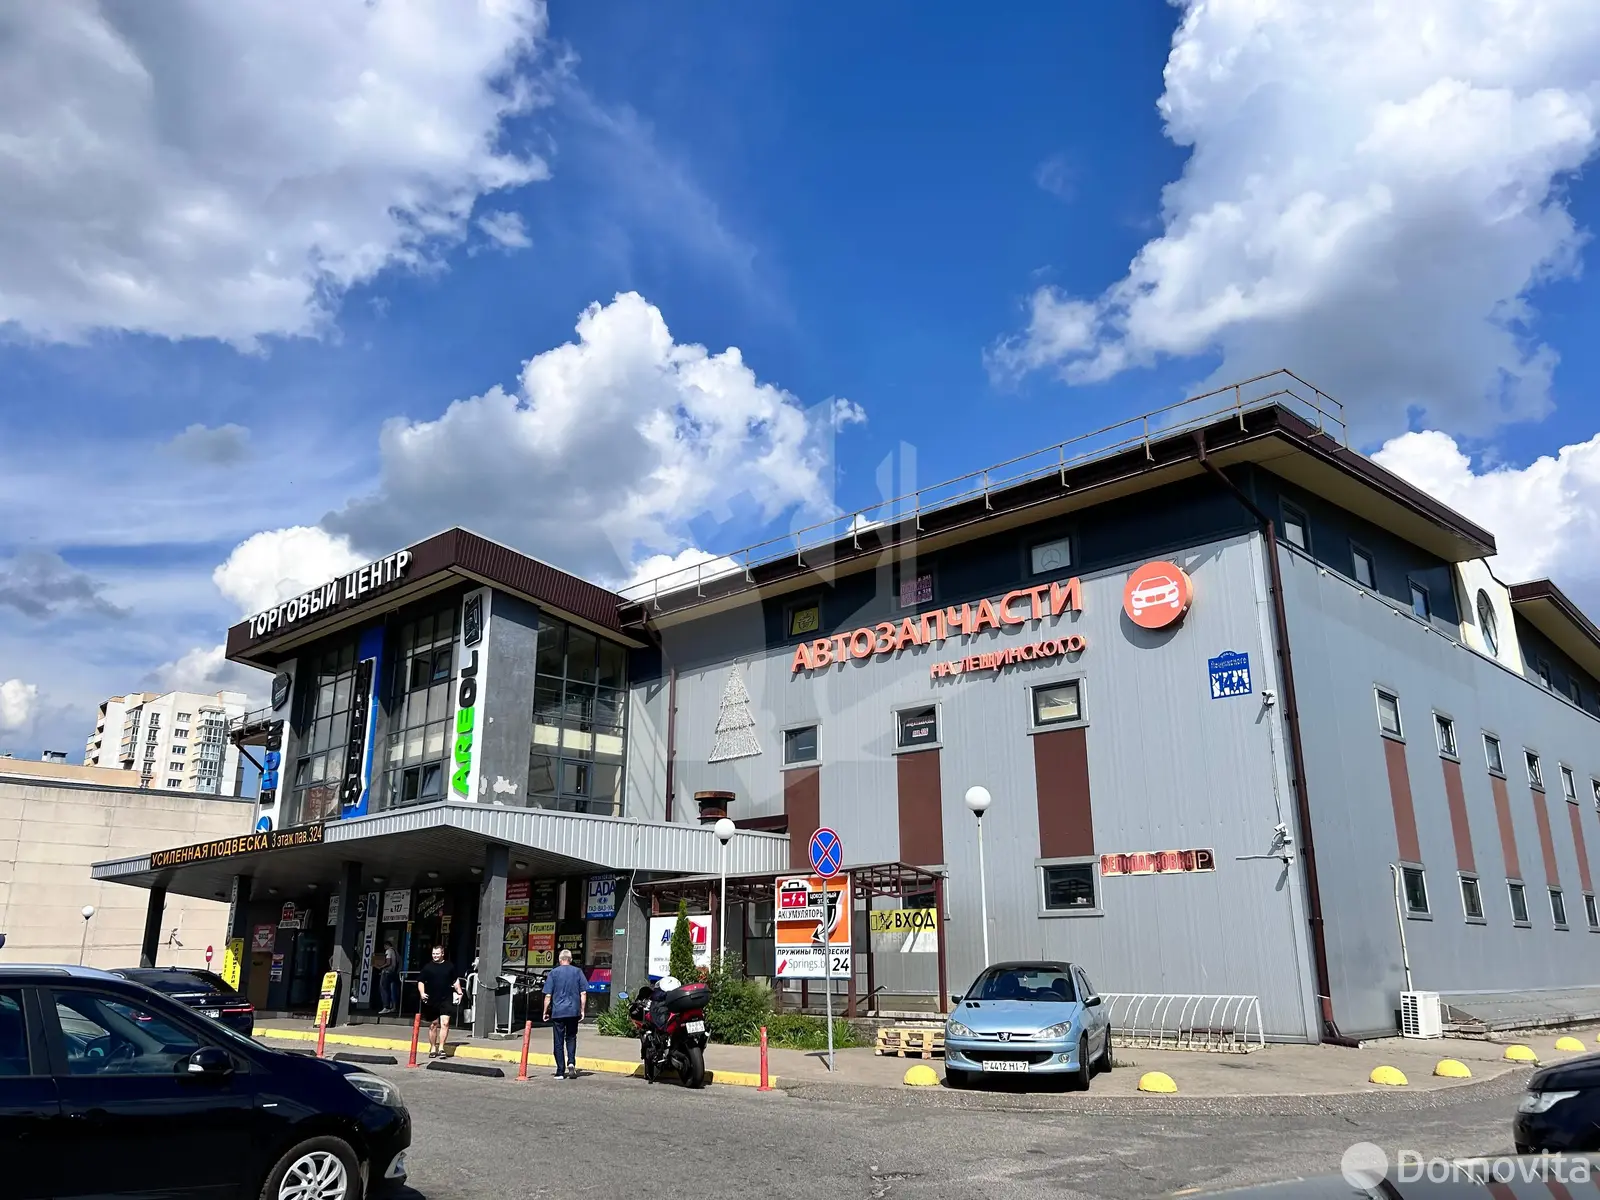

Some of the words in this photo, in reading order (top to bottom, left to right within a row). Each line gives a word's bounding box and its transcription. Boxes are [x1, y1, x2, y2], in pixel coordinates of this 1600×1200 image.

[248, 577, 339, 640] ТОРГОВЫЙ
[344, 551, 412, 600] ЦЕНТР
[790, 577, 1084, 674] АВТОЗАПЧАСТИ
[930, 662, 955, 679] НА
[452, 649, 479, 795] AREOL
[151, 846, 209, 867] УСИЛЕННАЯ
[210, 834, 269, 857] ПОДВЕСКА
[271, 836, 277, 848] 3
[277, 834, 294, 847] этаж
[589, 881, 616, 897] LADA
[895, 911, 936, 929] ВХОД
[788, 958, 828, 972] Springs.b
[832, 957, 849, 972] 24
[990, 1062, 1007, 1071] 4412
